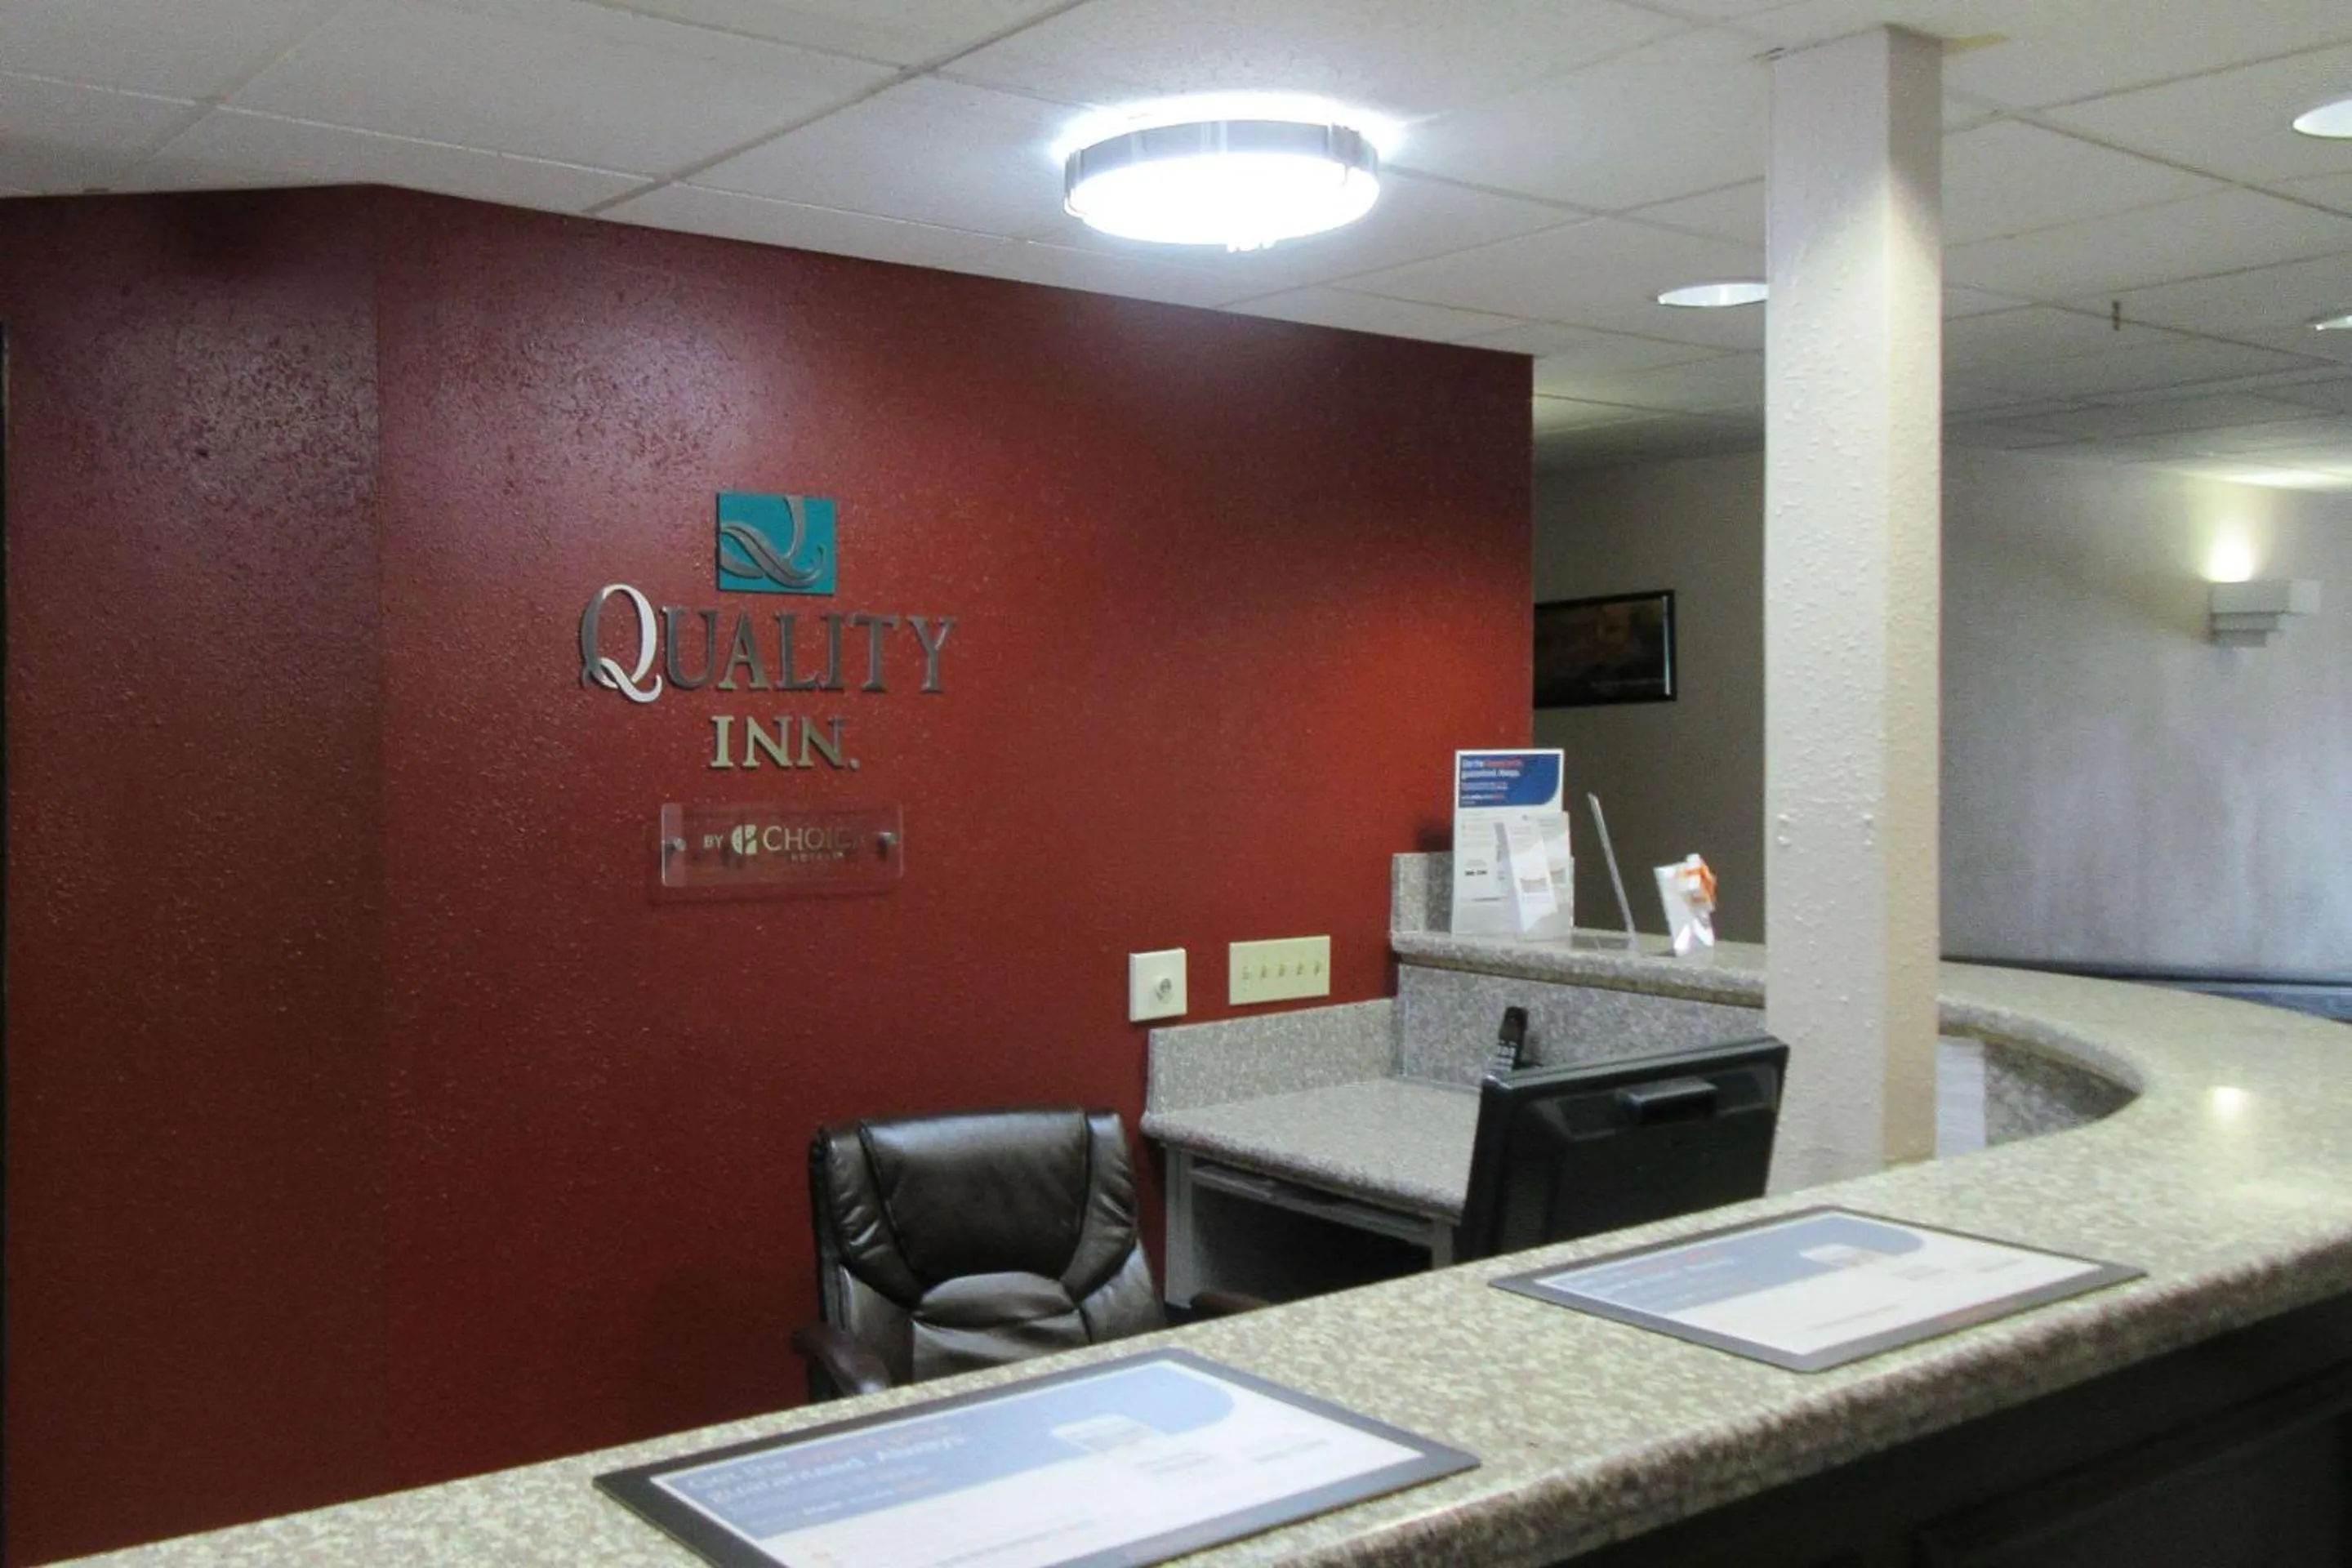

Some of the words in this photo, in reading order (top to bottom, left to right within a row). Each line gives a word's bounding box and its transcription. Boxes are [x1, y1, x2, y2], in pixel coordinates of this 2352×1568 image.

[581, 583, 956, 703] QUALITY
[703, 834, 724, 849] BY
[762, 824, 866, 851] CHOIC
